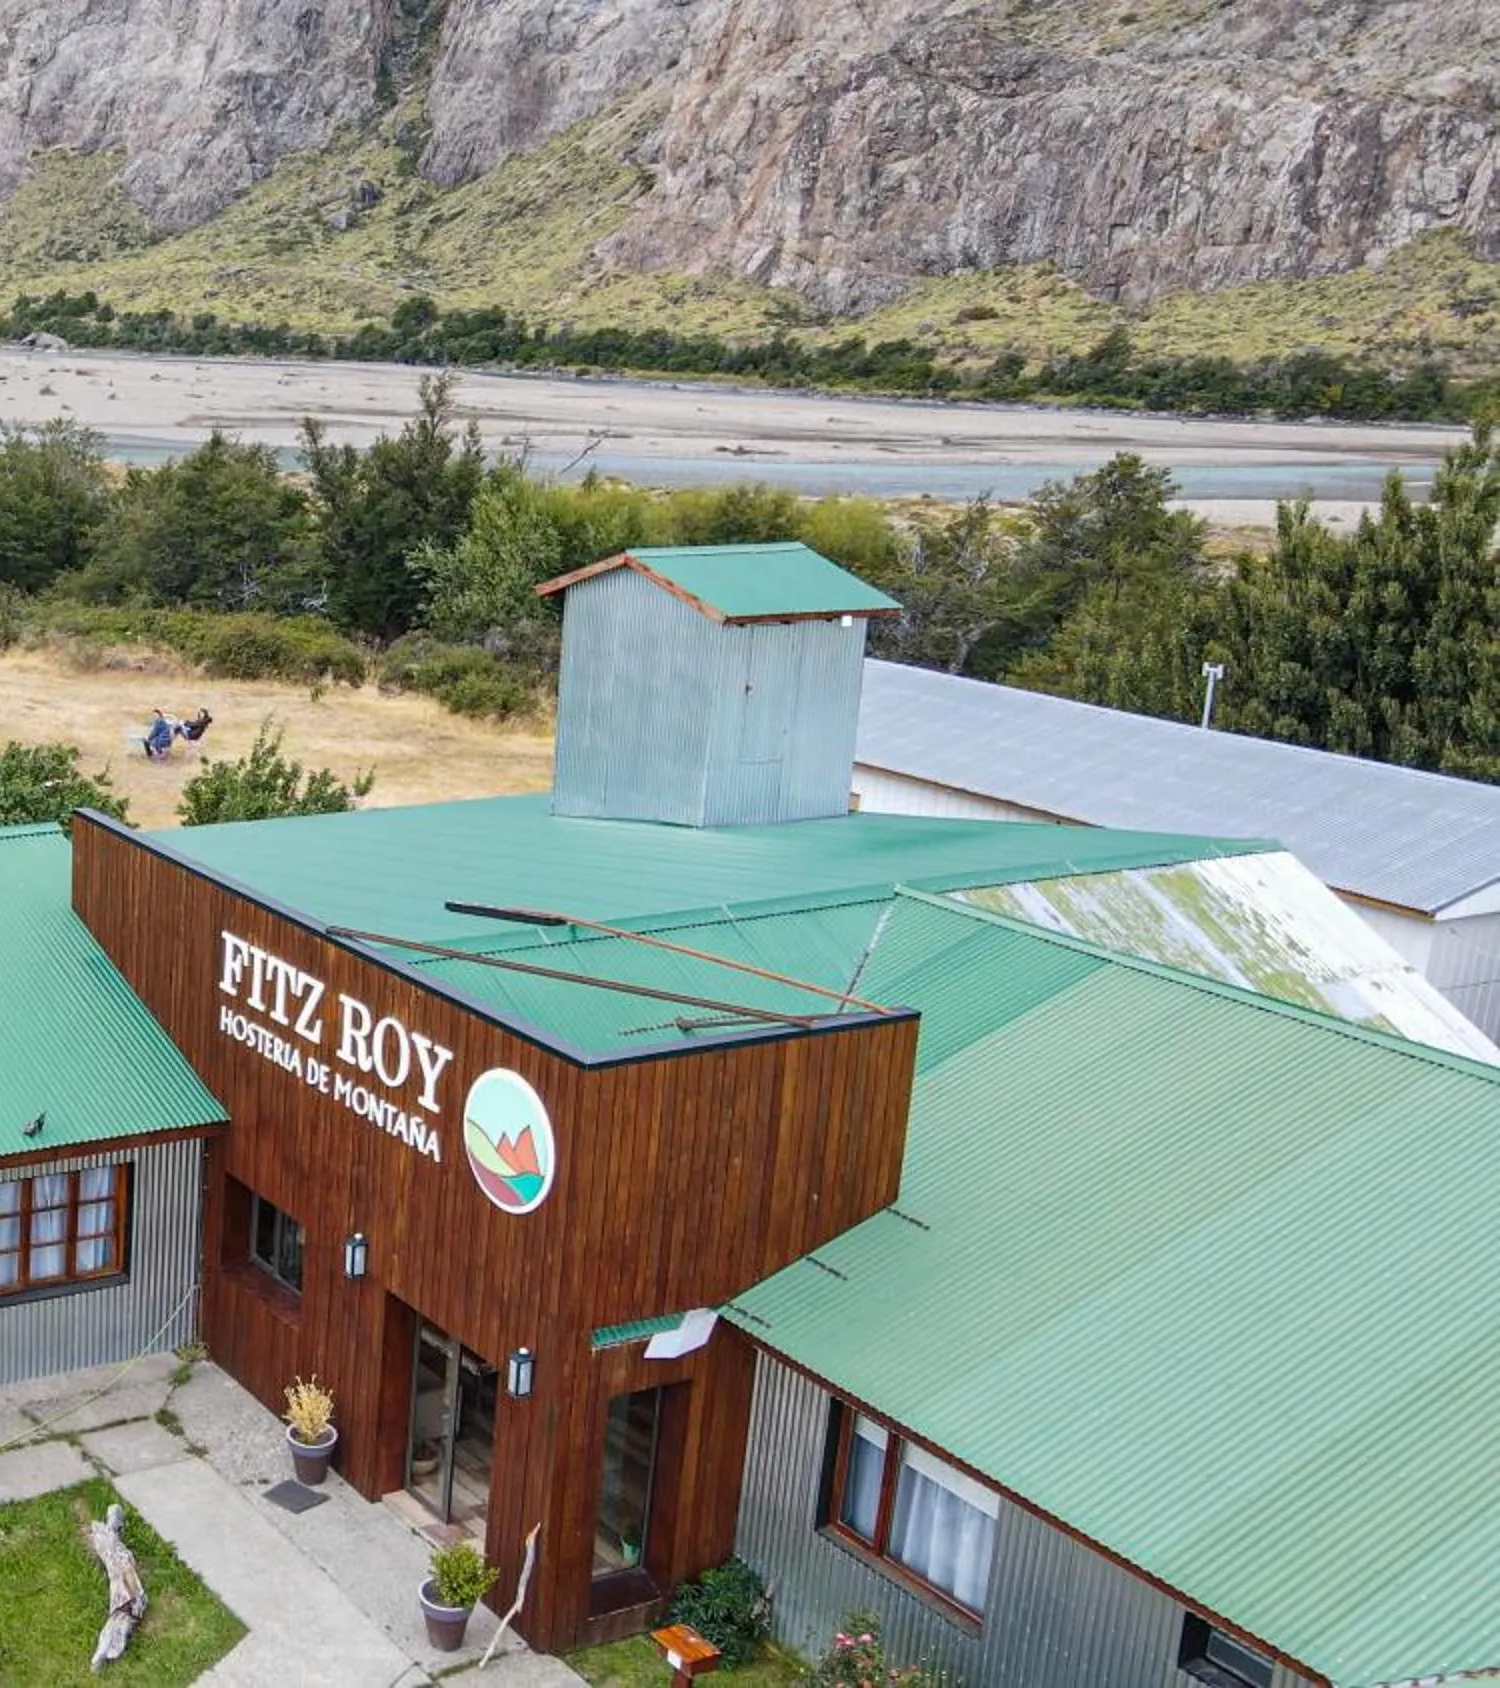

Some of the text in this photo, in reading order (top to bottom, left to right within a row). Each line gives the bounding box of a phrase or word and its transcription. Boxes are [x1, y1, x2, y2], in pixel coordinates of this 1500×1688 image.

[219, 930, 453, 1113] FITZ ROY
[220, 1006, 441, 1162] HOSTERIA DE MONTAÑA
